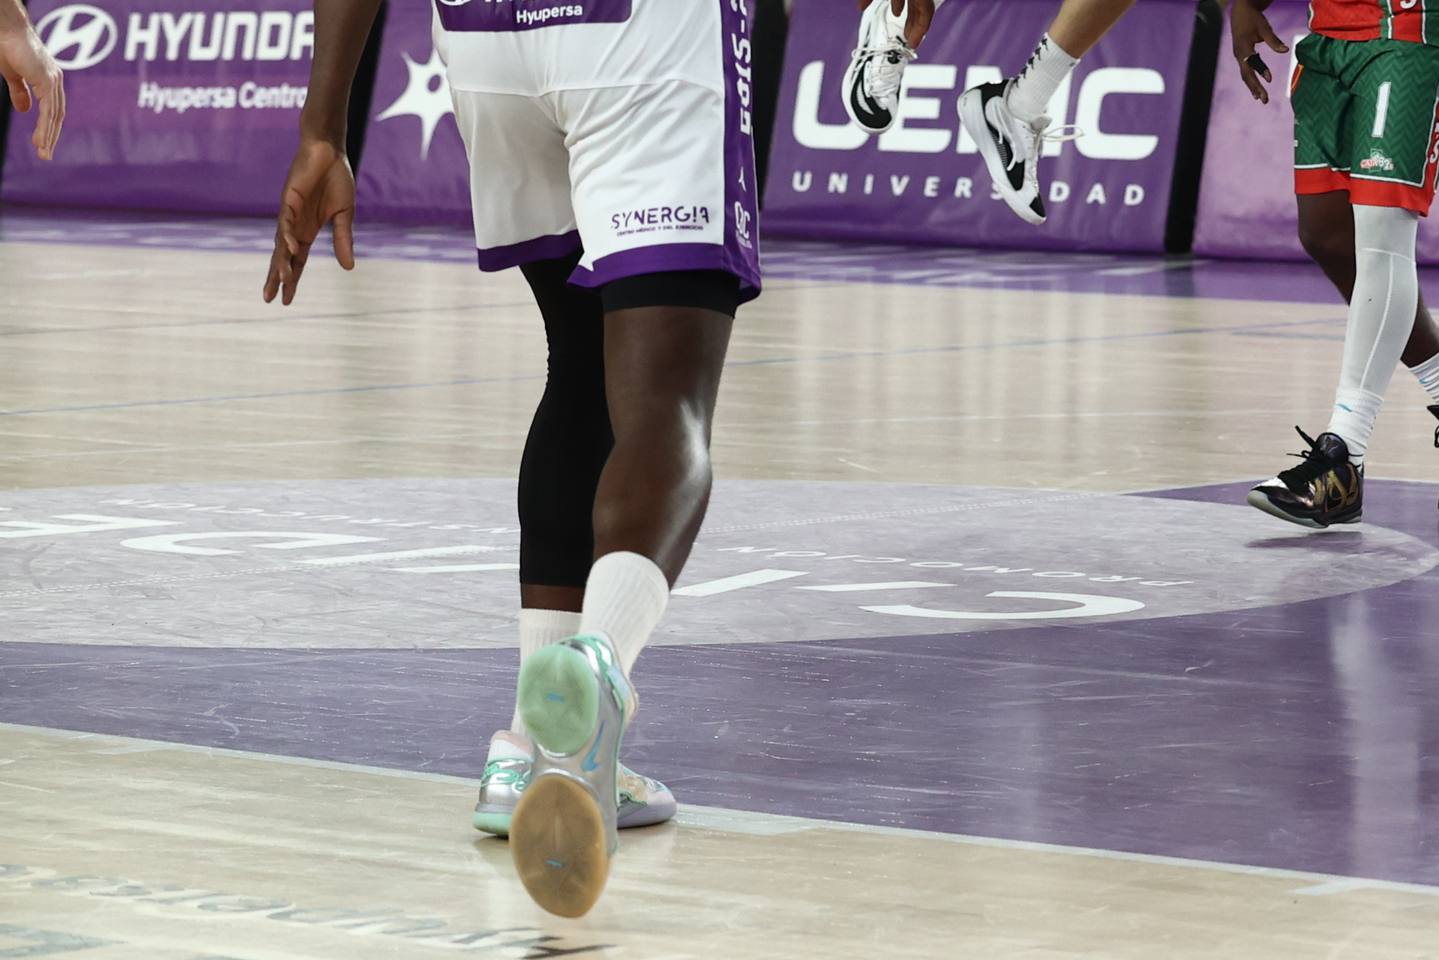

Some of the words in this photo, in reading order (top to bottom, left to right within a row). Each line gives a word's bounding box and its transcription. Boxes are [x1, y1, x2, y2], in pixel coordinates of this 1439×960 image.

[516, 3, 583, 24] Hyupersa
[124, 10, 314, 62] HYUNDA
[138, 81, 237, 114] Hyupersa
[1371, 82, 1391, 138] 1
[791, 170, 1145, 206] UNIVERSDAD
